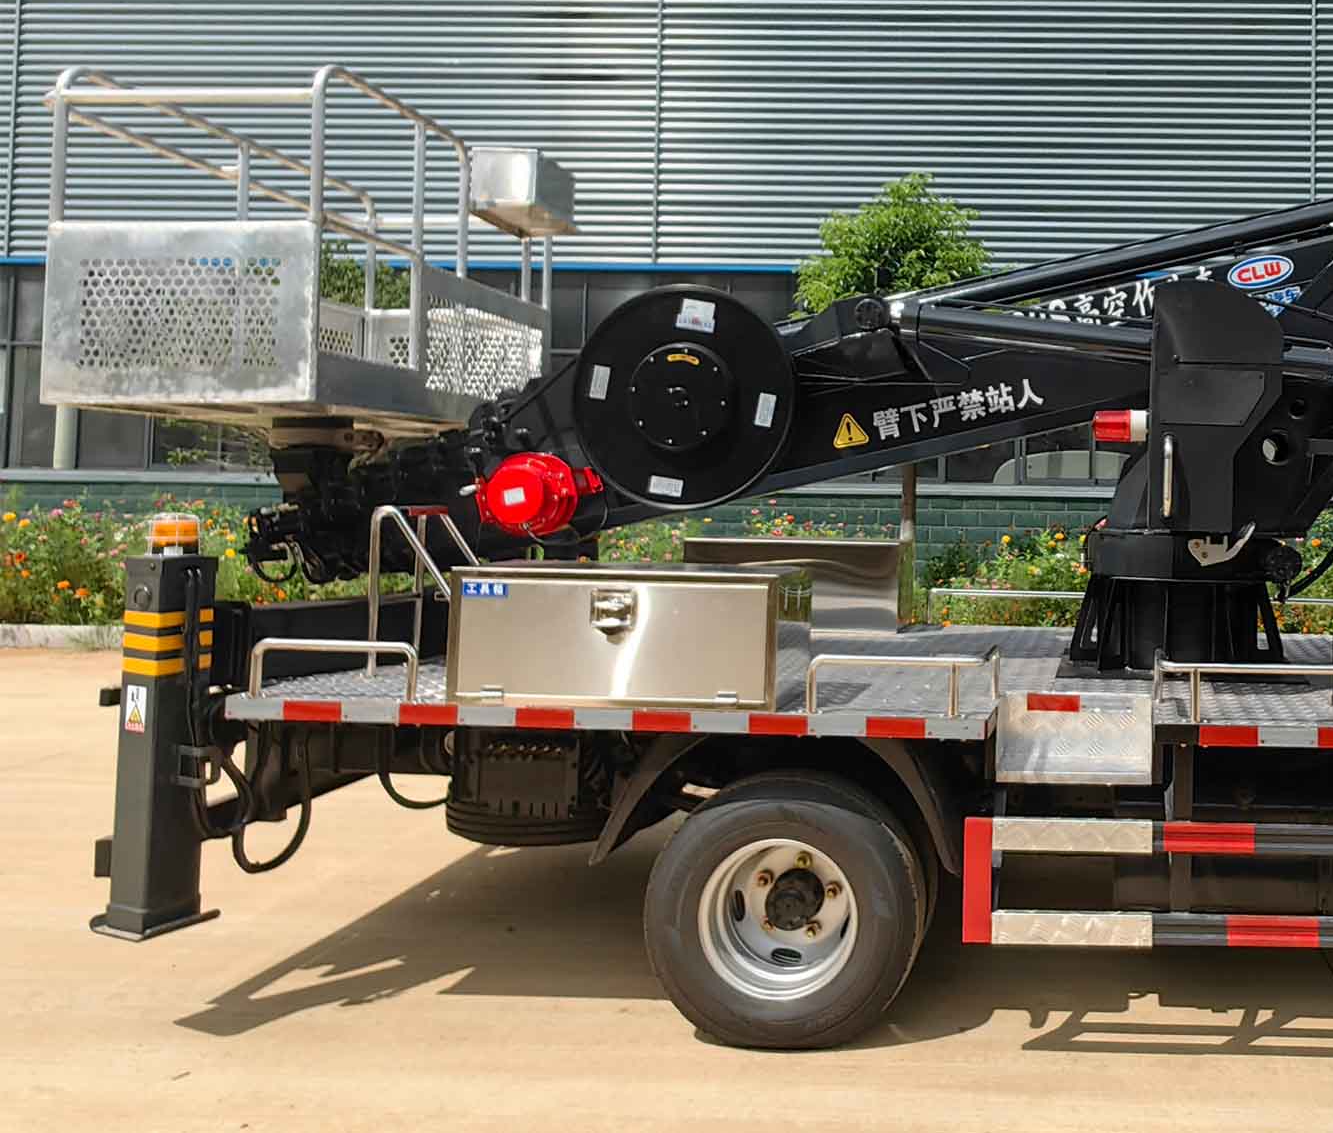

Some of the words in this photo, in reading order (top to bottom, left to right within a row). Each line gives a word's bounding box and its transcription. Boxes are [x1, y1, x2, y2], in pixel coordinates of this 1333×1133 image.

[1236, 261, 1282, 283] CLW
[872, 378, 1045, 441] 臂下严禁站人
